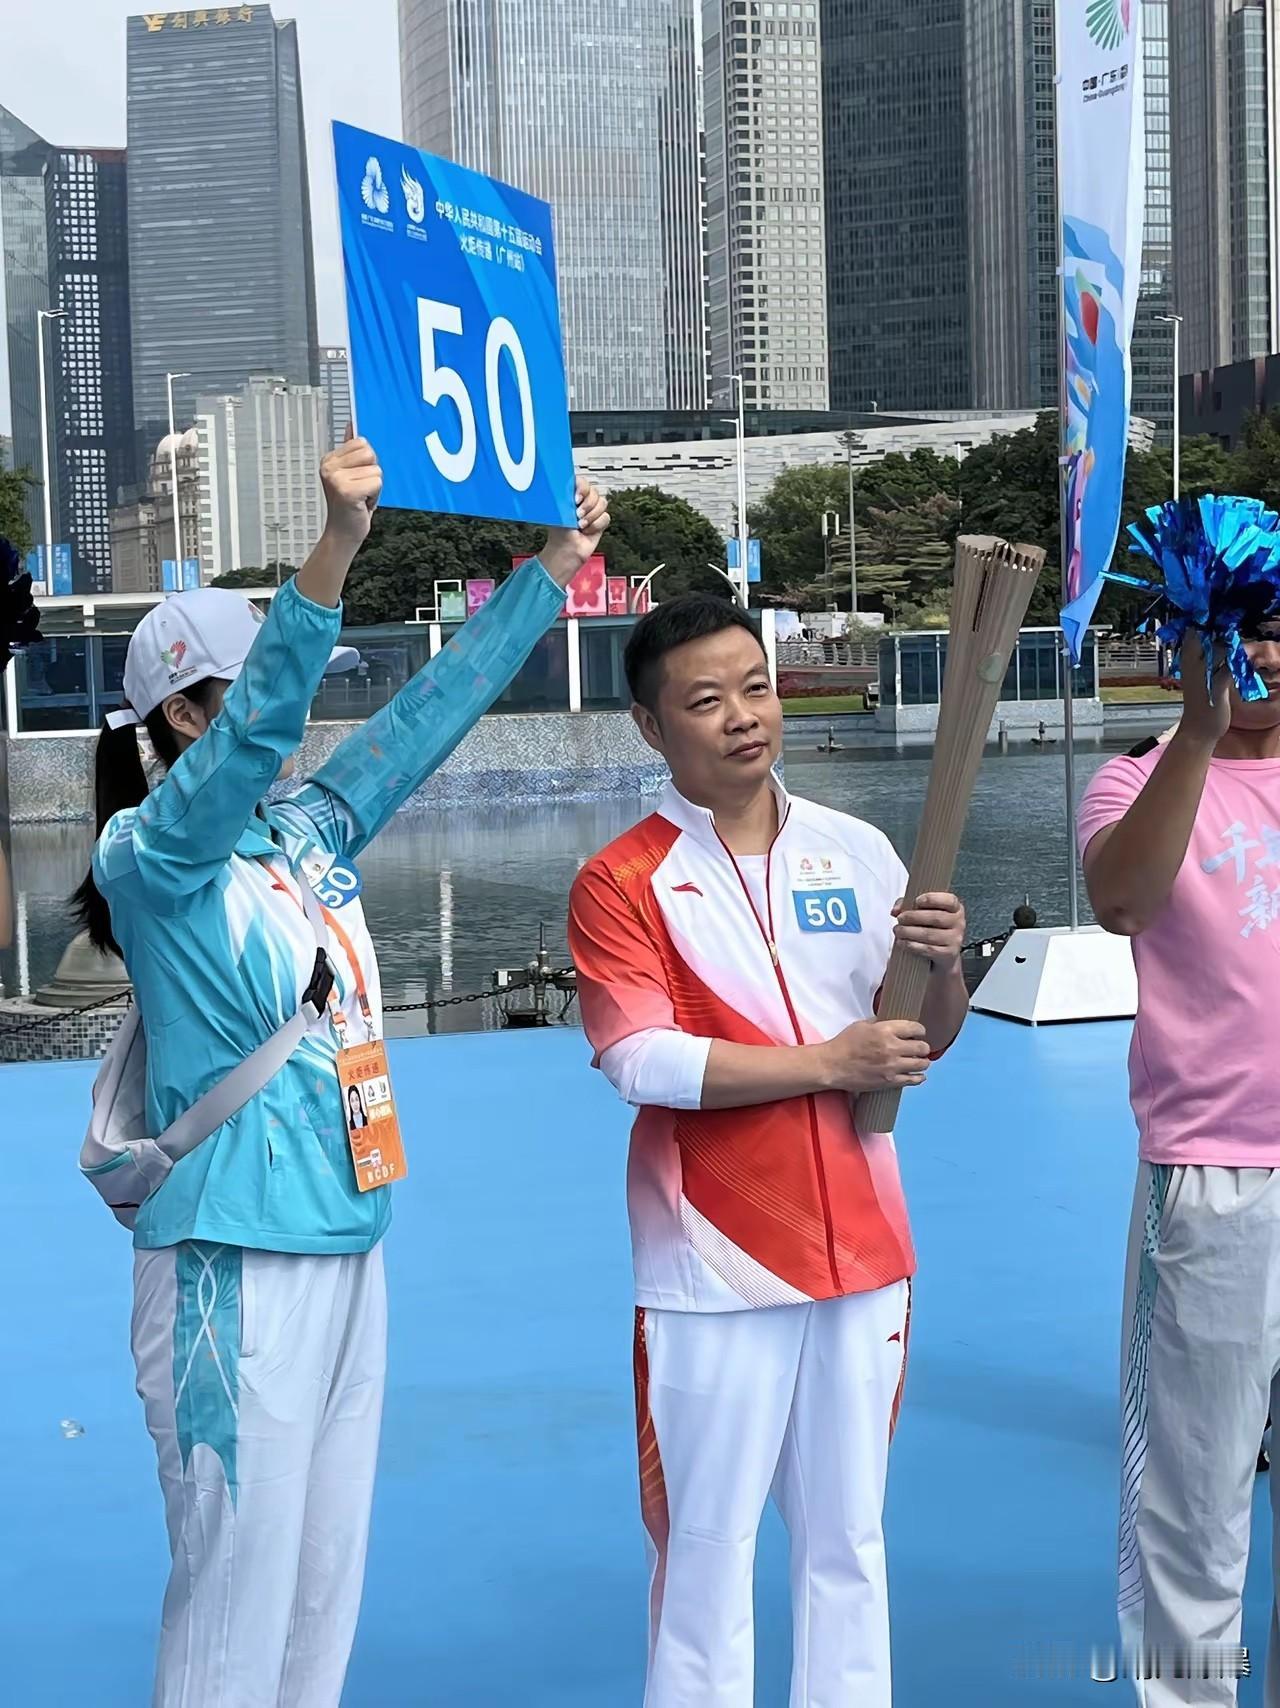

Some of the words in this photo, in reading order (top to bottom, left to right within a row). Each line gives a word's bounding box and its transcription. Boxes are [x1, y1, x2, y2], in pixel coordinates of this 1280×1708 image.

[435, 200, 543, 257] 中华人民共和国第十五届运动会
[417, 296, 536, 492] 50
[312, 866, 358, 908] 50
[804, 896, 847, 927] 50
